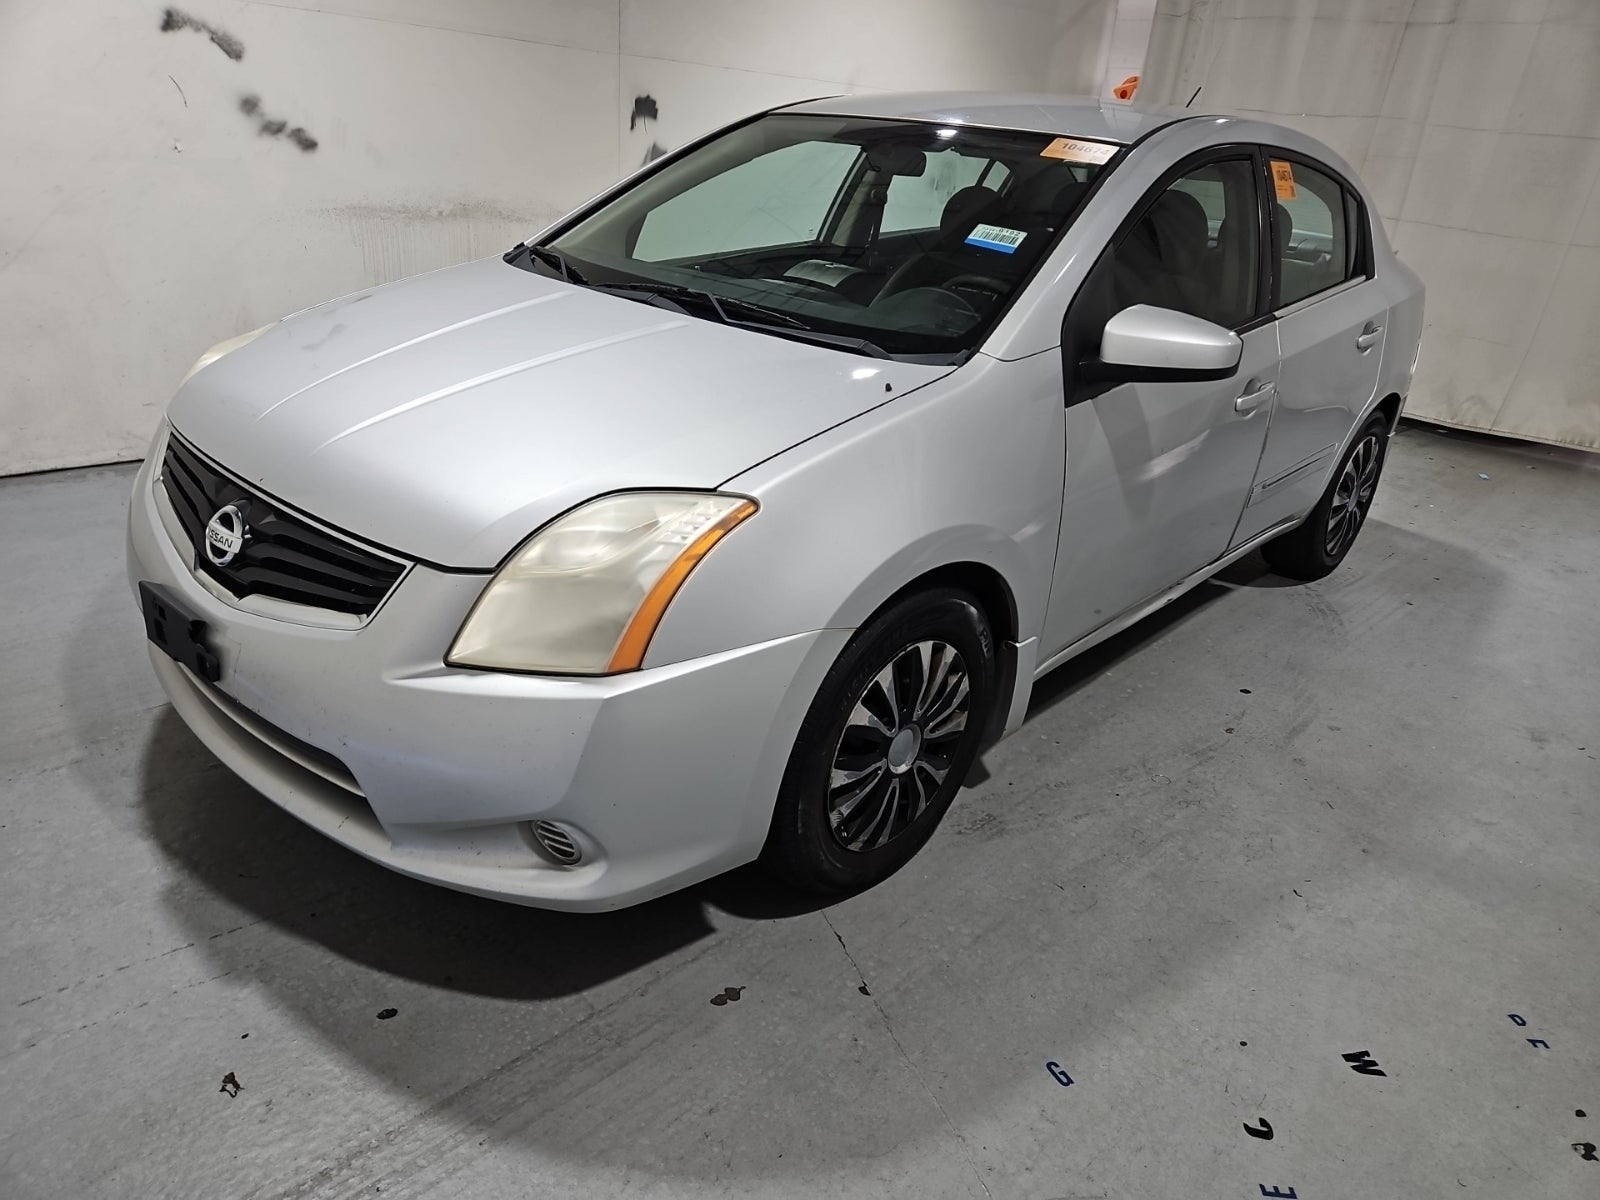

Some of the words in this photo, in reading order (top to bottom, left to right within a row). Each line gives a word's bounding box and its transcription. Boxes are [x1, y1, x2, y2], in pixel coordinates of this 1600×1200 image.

[207, 526, 233, 549] ISSAN
[1046, 1061, 1075, 1087] G
[1259, 1183, 1297, 1200] E
